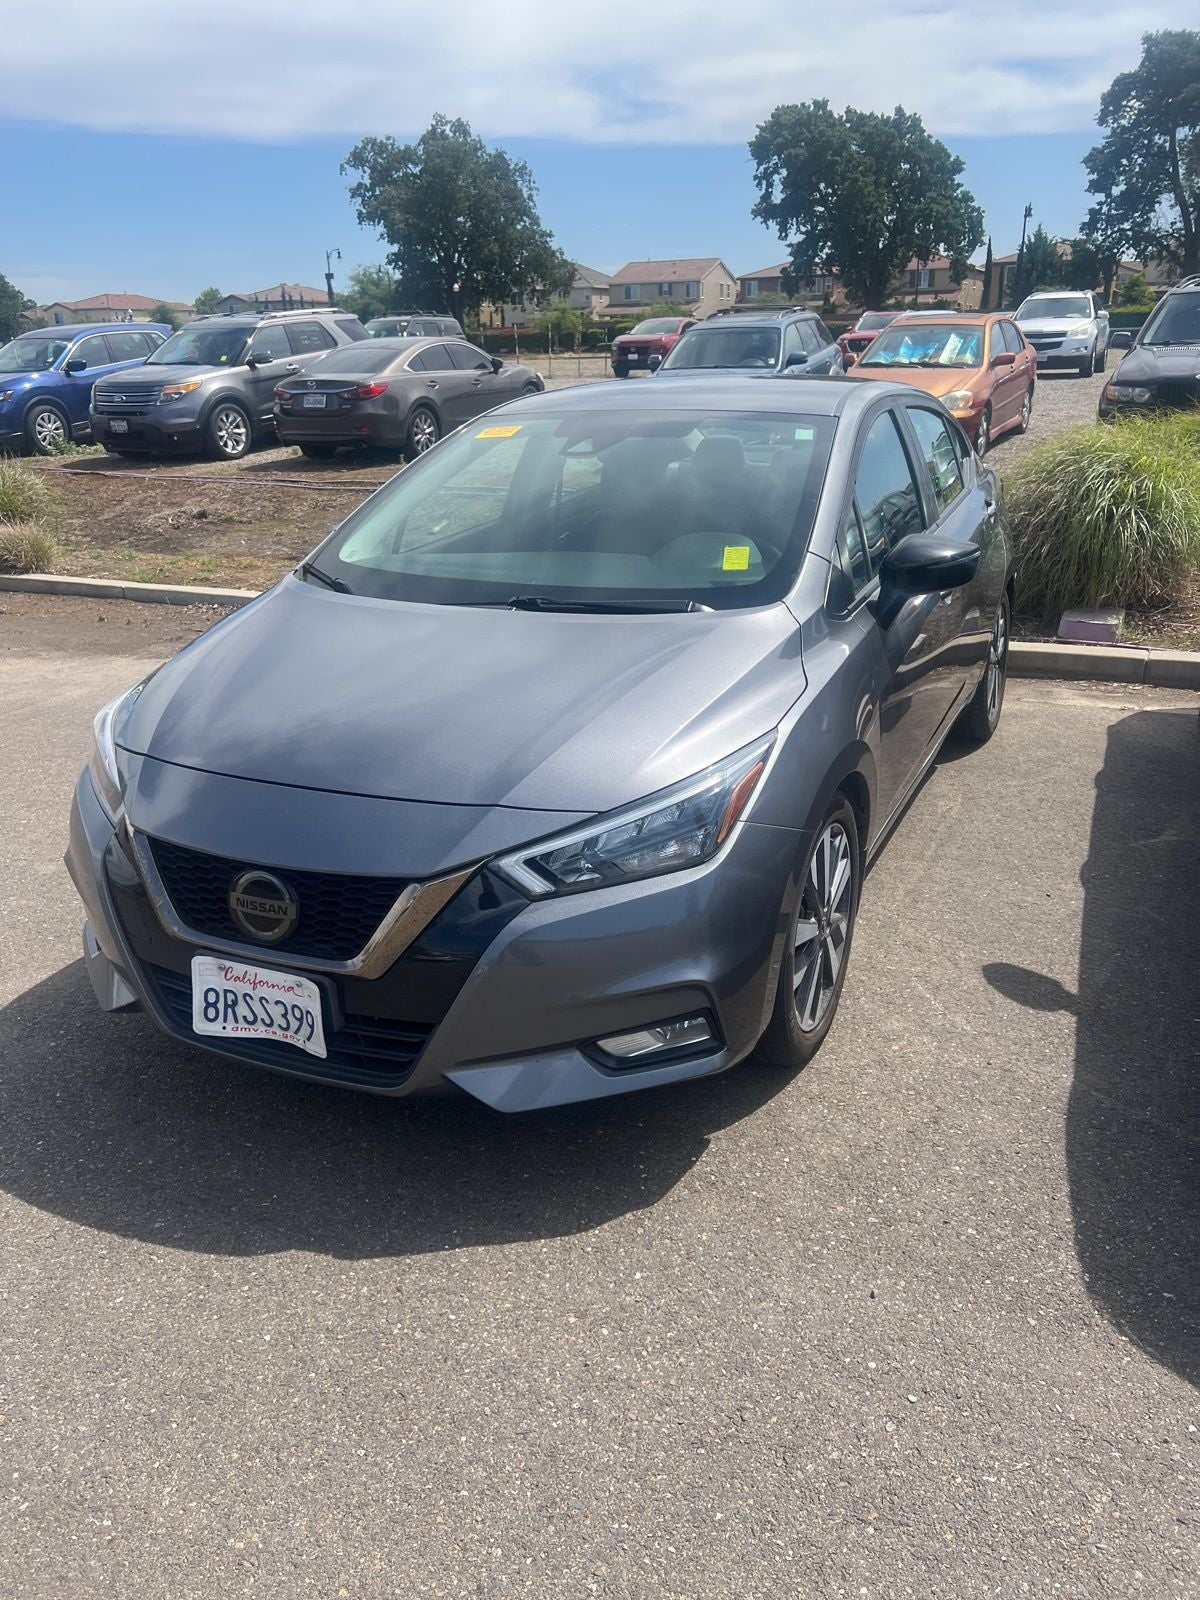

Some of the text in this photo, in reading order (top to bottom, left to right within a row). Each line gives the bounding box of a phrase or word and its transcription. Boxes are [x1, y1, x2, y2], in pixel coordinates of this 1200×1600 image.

[236, 897, 288, 916] NISSAN
[224, 966, 303, 998] California
[203, 987, 315, 1042] 8RSS399
[231, 1026, 301, 1042] dmv.ca.gov
